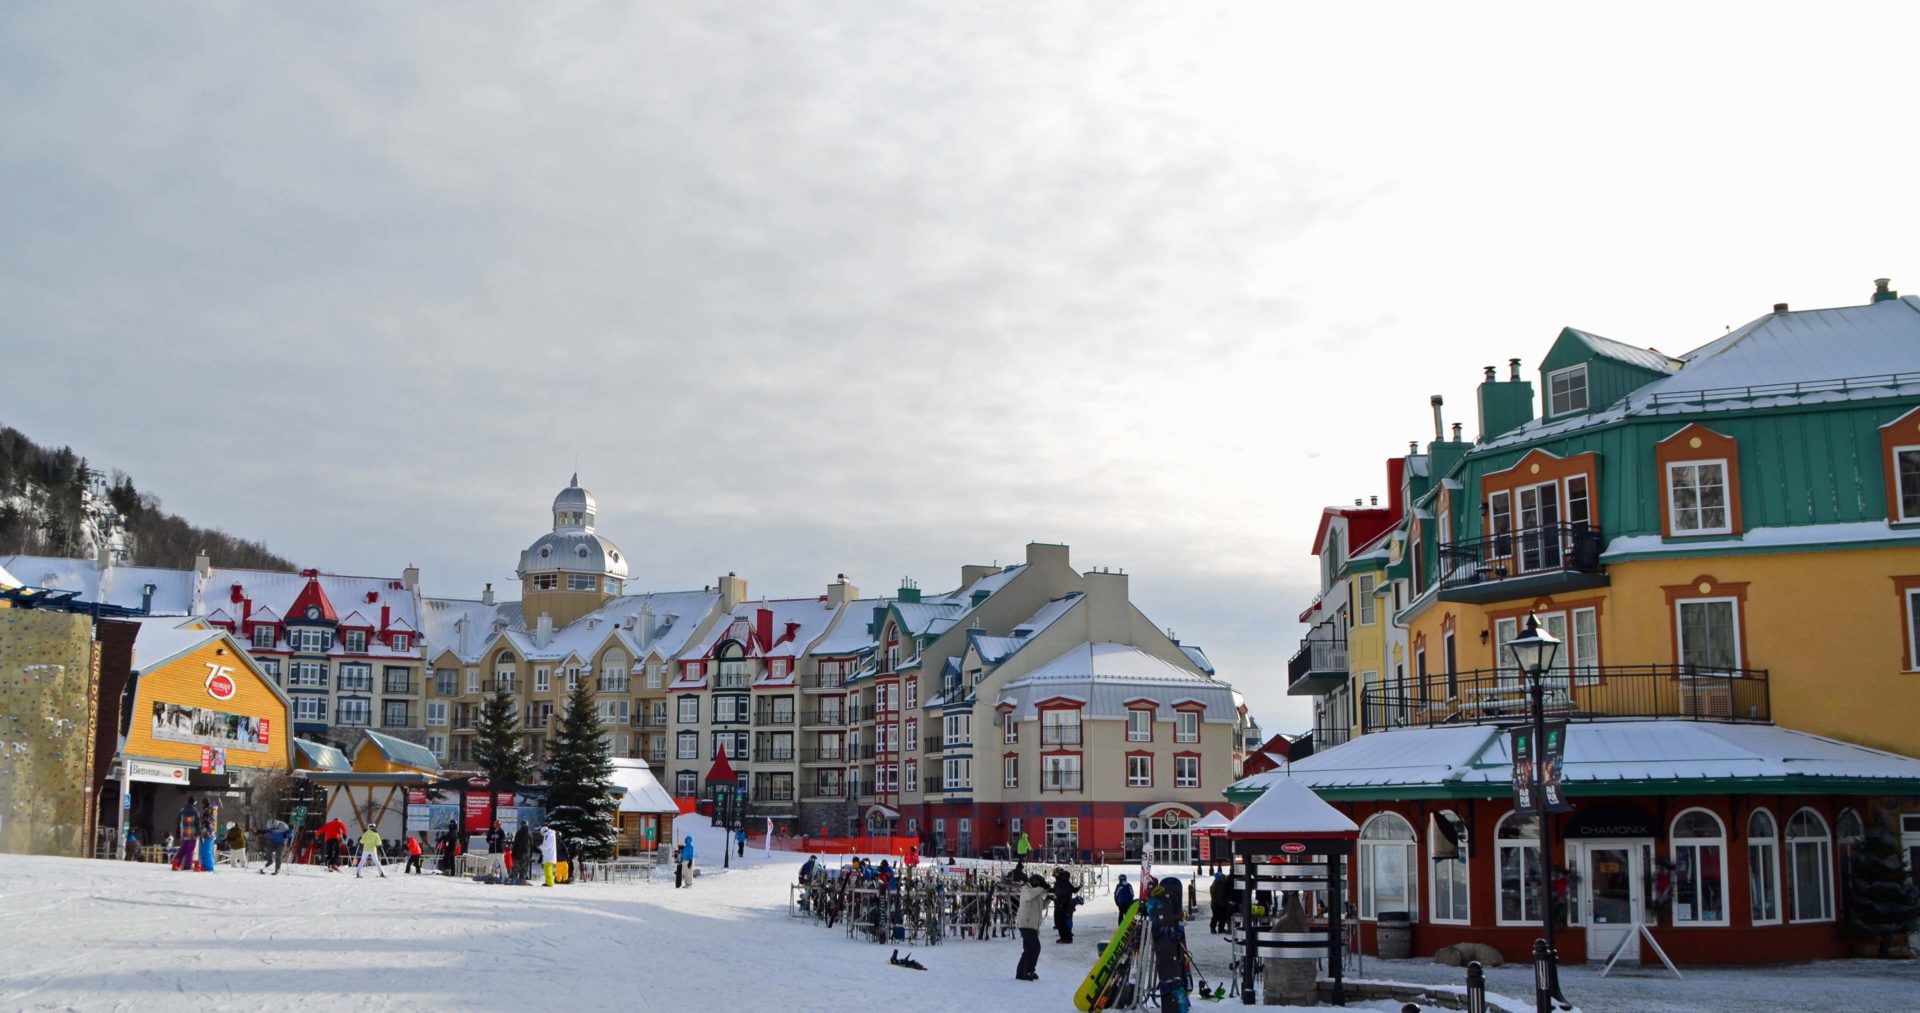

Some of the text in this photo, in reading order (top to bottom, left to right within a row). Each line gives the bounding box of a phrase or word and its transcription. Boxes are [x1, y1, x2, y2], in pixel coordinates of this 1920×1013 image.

[204, 662, 235, 700] 75
[87, 641, 101, 772] TOUR D'ESCALADE
[1580, 826, 1648, 835] CHAMONIX
